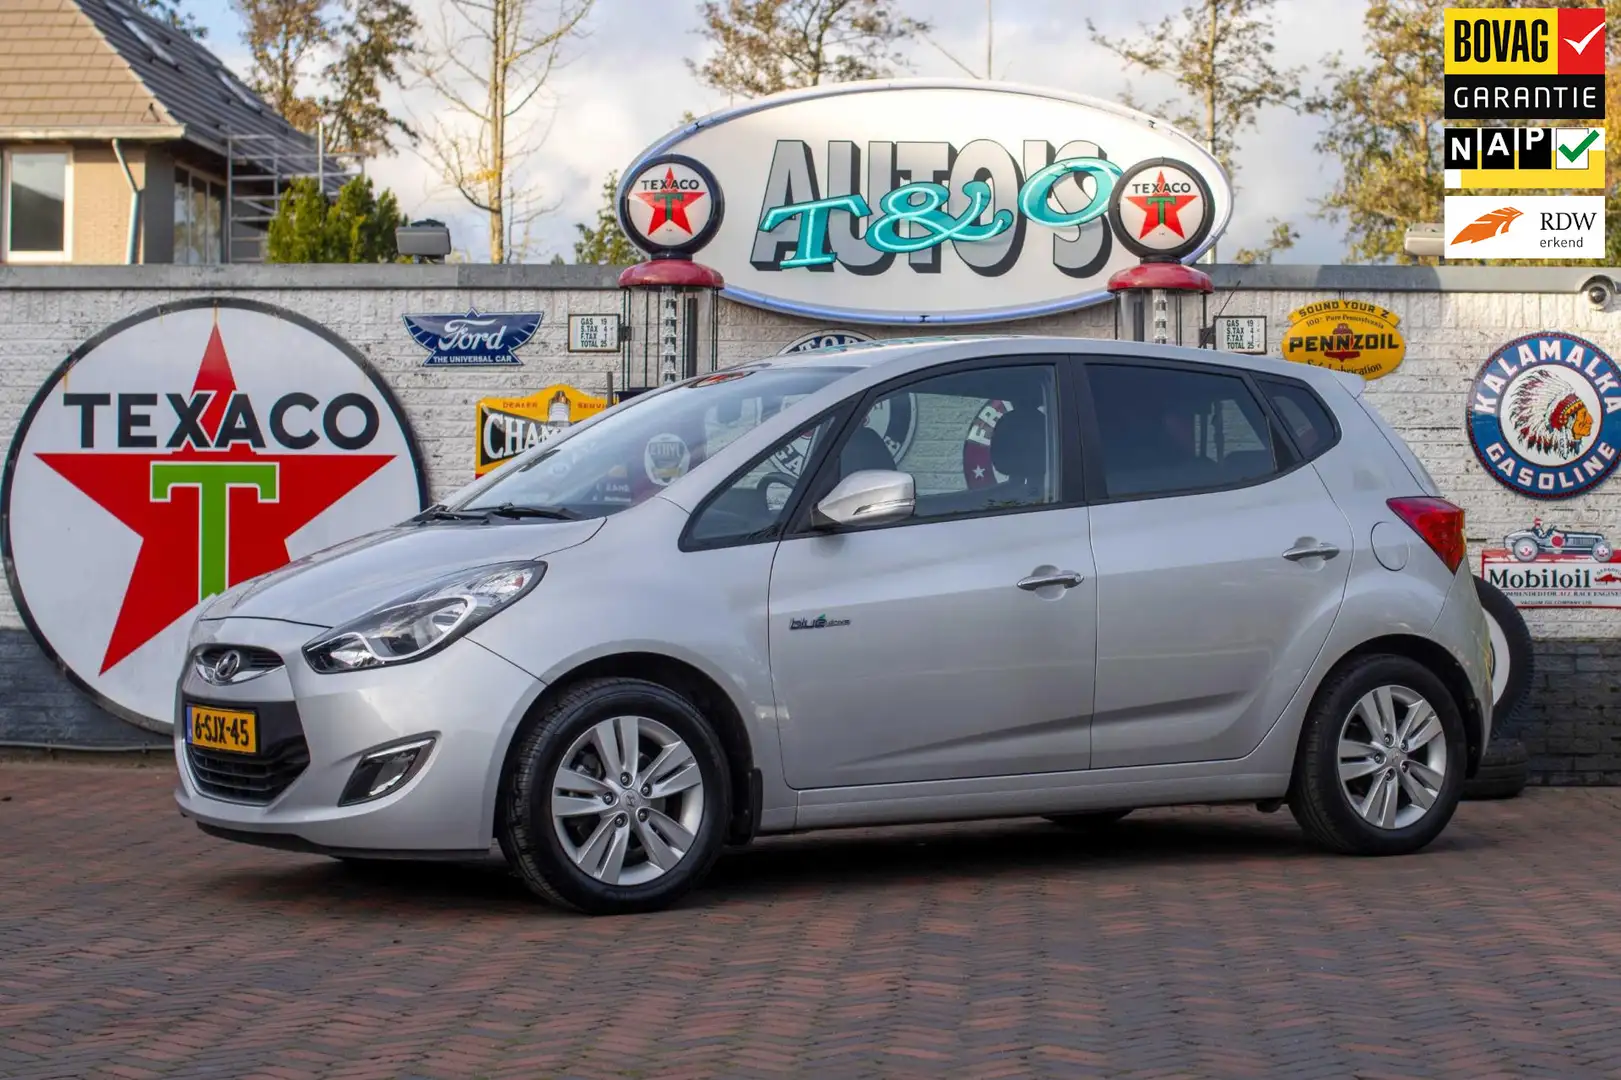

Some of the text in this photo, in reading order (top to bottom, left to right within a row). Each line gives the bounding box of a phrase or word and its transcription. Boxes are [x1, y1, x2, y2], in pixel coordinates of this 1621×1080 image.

[641, 180, 699, 190] TEXACO
[1132, 182, 1191, 193] TEXACO
[654, 192, 684, 220] T
[1146, 195, 1176, 224] T
[1298, 301, 1339, 317] SOUND
[1343, 301, 1376, 313] YOUR
[580, 317, 594, 325] GAS
[1226, 319, 1240, 327] GAS
[438, 318, 508, 351] Ford
[580, 332, 597, 340] F.TAX
[580, 340, 598, 348] TOTAL
[1288, 333, 1400, 352] PENNZOIL
[1226, 342, 1245, 350] TOTAL
[433, 355, 512, 363] THE UNIVERSAL CAR
[1475, 340, 1621, 414] KALAMALKA
[63, 391, 380, 451] TEXACO
[1485, 441, 1615, 490] GASOLINE
[150, 462, 280, 603] T
[1489, 568, 1592, 588] Mobiloil
[194, 713, 250, 746] 6-SJX-45
